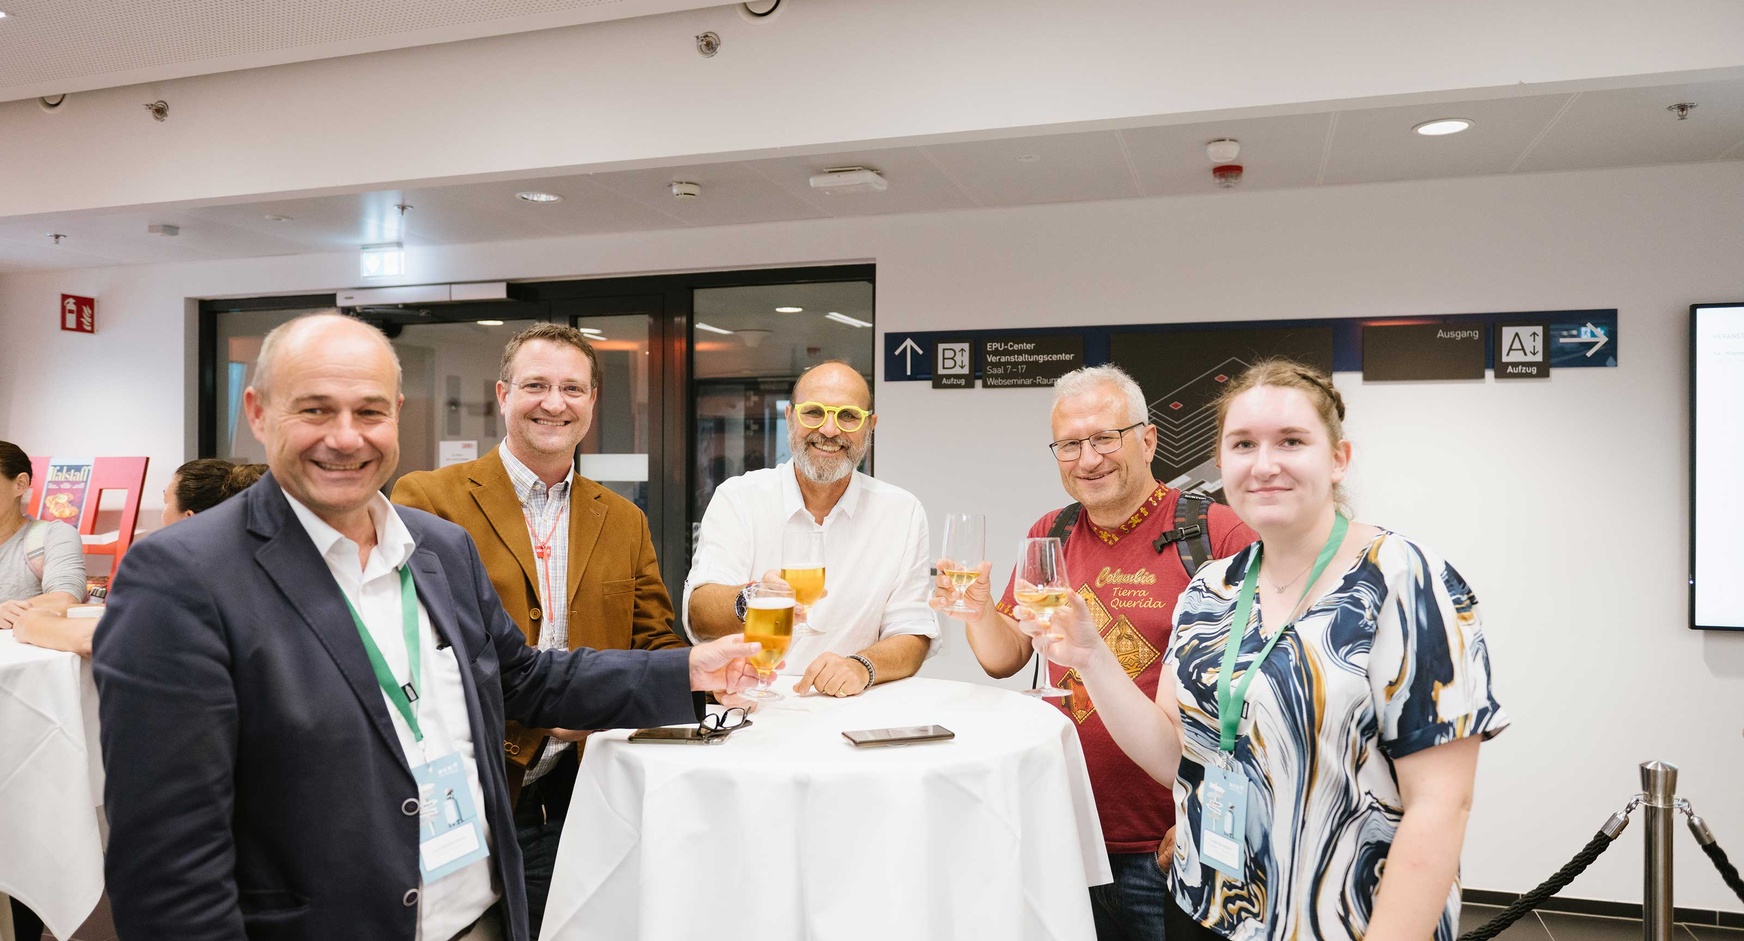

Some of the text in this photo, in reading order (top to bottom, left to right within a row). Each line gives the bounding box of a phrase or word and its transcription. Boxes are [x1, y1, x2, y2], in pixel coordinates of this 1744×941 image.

[1437, 329, 1479, 340] Ausgang
[986, 342, 1036, 351] EPU-Center
[1506, 331, 1528, 357] A
[942, 348, 957, 370] B
[986, 353, 1075, 363] Veranstaltungscenter
[986, 365, 1005, 374] Saal
[1506, 365, 1537, 375] Aufzug
[941, 377, 966, 386] Aufzug
[1095, 566, 1157, 589] Colombia
[1112, 587, 1150, 597] Tierra
[1110, 597, 1167, 610] Querida
